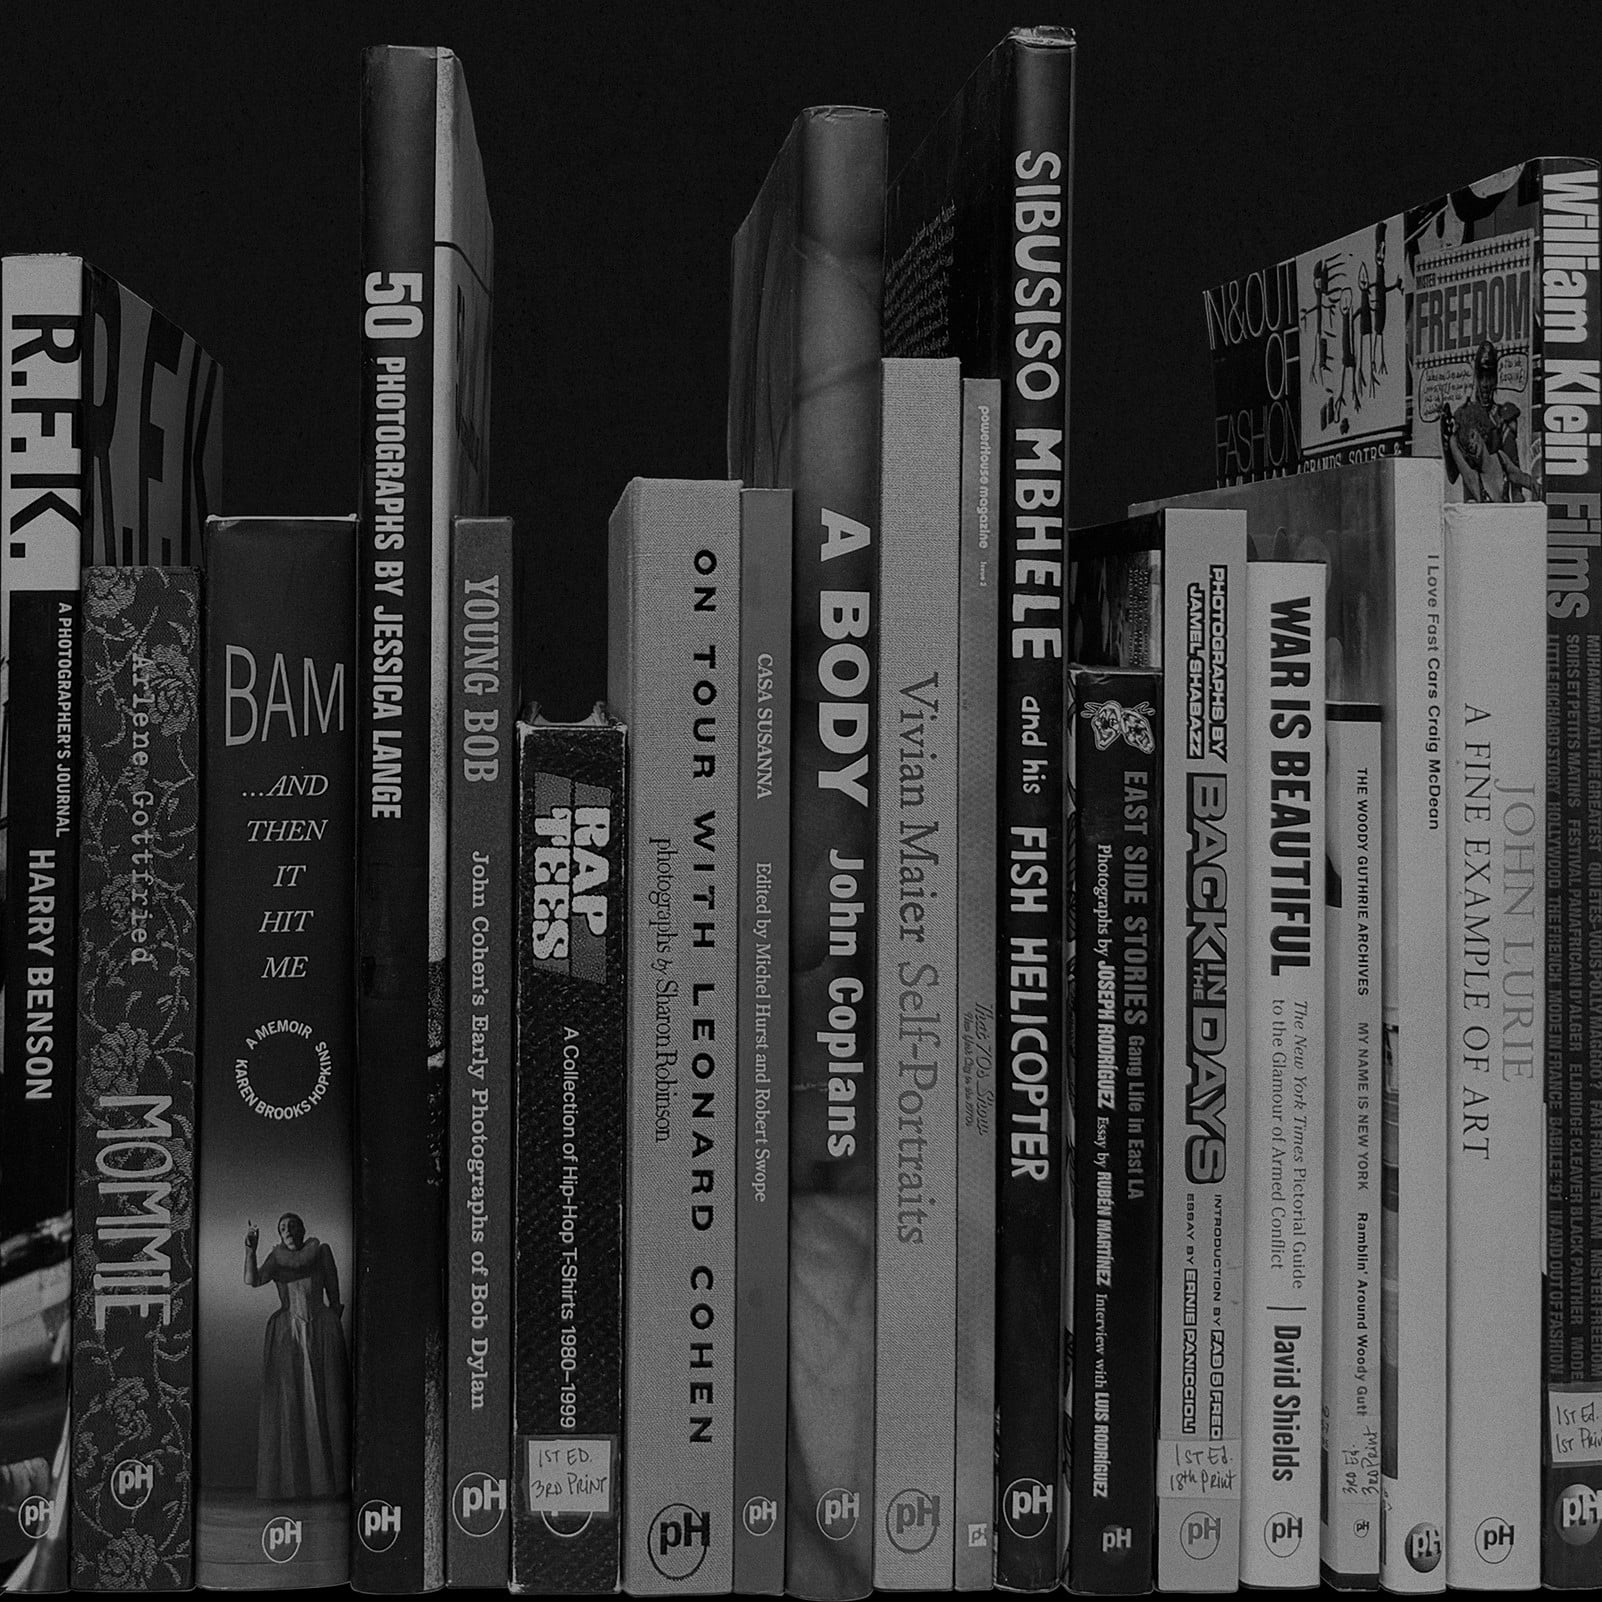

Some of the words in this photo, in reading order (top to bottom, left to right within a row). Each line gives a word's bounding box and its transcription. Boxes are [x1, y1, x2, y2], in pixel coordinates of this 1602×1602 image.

[1014, 150, 1062, 400] SIBUSISO
[1542, 169, 1601, 344] William
[364, 271, 424, 339] 50
[1415, 270, 1530, 356] FREEDOM
[1265, 327, 1299, 400] OF
[11, 315, 82, 558] R.F.K.
[977, 405, 991, 485] powerHouse
[1215, 400, 1301, 477] FASHION
[1542, 359, 1601, 477] Klein
[374, 357, 406, 550] PHOTOGRAPHS
[820, 507, 871, 562] A
[976, 486, 991, 549] magazine
[1012, 428, 1062, 660] MBHELE
[373, 560, 403, 597] BY
[693, 549, 716, 613] ON
[1428, 565, 1440, 608] Love
[1546, 492, 1602, 619] Films
[55, 602, 72, 616] A
[463, 575, 499, 696] YOUNG
[1187, 583, 1204, 657] JAMEL
[1210, 565, 1227, 721] PHOTOGRAPHS
[1270, 597, 1311, 689] WAR
[1428, 613, 1440, 652] Fast
[55, 618, 72, 760] PHOTOGRAPHER'S
[225, 644, 345, 747] BAM
[371, 604, 402, 720] JESSICA
[756, 653, 773, 703] CASA
[1428, 657, 1440, 699] Cars
[131, 656, 154, 766] Arlene
[692, 645, 716, 780] TOUR
[817, 590, 871, 809] BODY
[1021, 695, 1049, 747] and
[1187, 658, 1204, 759] SHABAZZ
[1270, 699, 1311, 740] IS
[1425, 705, 1441, 753] Craig
[1463, 702, 1491, 727] A
[370, 729, 401, 819] LANGE
[463, 708, 499, 783] BOB
[756, 707, 773, 800] SUSANNA
[899, 672, 940, 810] Vivian
[1210, 724, 1227, 763] BY
[55, 763, 72, 838] JOURNAL
[242, 774, 329, 797] ...AND
[1021, 759, 1049, 795] his
[1123, 770, 1148, 836] EAST
[1356, 768, 1369, 796] THE
[1428, 759, 1441, 831] McDean
[1463, 742, 1491, 823] FINE
[247, 820, 328, 842] THEN
[1356, 799, 1369, 852] WOODY
[1493, 778, 1537, 918] JOHN
[131, 791, 154, 965] Gottfried
[272, 865, 306, 887] IT
[471, 850, 489, 909] John
[531, 807, 573, 961] TEES
[571, 807, 611, 936] RAP
[649, 837, 677, 954] photographs
[692, 811, 715, 949] WITH
[755, 862, 771, 917] Edited
[899, 820, 940, 943] Maier
[1009, 826, 1049, 914] FISH
[1092, 843, 1113, 936] Photographs
[1123, 845, 1148, 905] SIDE
[1185, 773, 1227, 960] BACK
[1270, 750, 1311, 977] BEAUTIFUL
[1356, 856, 1369, 920] GUTHRIE
[25, 849, 54, 955] HARRY
[258, 910, 314, 932] HIT
[753, 918, 771, 939] by
[828, 848, 865, 957] John
[1463, 838, 1491, 1011] EXAMPLE
[261, 956, 309, 979] ME
[471, 916, 489, 1006] Cohen's
[651, 958, 673, 976] by
[755, 942, 771, 999] Michel
[1092, 938, 1113, 957] by
[1123, 915, 1148, 1026] STORIES
[1191, 963, 1205, 1001] THE
[1207, 963, 1226, 1000] IN
[1356, 923, 1369, 997] ARCHIVES
[655, 979, 679, 1049] Sharon
[975, 1002, 994, 1041] That
[1096, 959, 1116, 1021] JOSEPH
[1291, 1000, 1308, 1030] The
[1502, 938, 1536, 1083] LURIE
[25, 967, 54, 1099] BENSON
[245, 1036, 257, 1050] A
[255, 1019, 313, 1041] MEMOIR
[467, 1014, 489, 1080] Early
[564, 1026, 579, 1041] A
[754, 1002, 770, 1050] Hurst
[1009, 937, 1049, 1182] HELICOPTER
[1126, 1034, 1145, 1078] Gang
[1291, 1034, 1308, 1069] New
[1463, 1026, 1491, 1073] OF
[234, 1058, 258, 1112] KAREN
[254, 1098, 311, 1121] BROOKS
[307, 1040, 333, 1111] HOPKINS
[562, 1045, 579, 1139] Collection
[754, 1053, 770, 1084] and
[816, 976, 865, 1158] Coplans
[975, 1043, 994, 1079] 70s
[1096, 1022, 1119, 1111] RODRÍGUEZ
[1185, 1006, 1227, 1185] DAYS
[1291, 1075, 1308, 1110] York
[654, 1050, 678, 1144] Robinson
[691, 983, 715, 1232] LEONARD
[753, 1087, 770, 1145] Robert
[896, 961, 941, 1246] Self-Portraits
[975, 1081, 994, 1137] Show
[1127, 1081, 1145, 1113] Life
[1127, 1118, 1145, 1135] in
[1463, 1085, 1491, 1161] ART
[467, 1088, 489, 1243] Photographs
[562, 1143, 578, 1164] of
[1127, 1139, 1145, 1175] East
[1291, 1115, 1308, 1163] Times
[559, 1166, 578, 1244] Hip-Hop
[751, 1147, 769, 1203] Swope
[1127, 1179, 1145, 1200] LA
[1291, 1167, 1308, 1238] Pictorial
[93, 1095, 172, 1330] MOMMIE
[1186, 1193, 1195, 1241] ESSAY
[470, 1251, 488, 1276] of
[560, 1248, 578, 1320] T-Shirts
[1185, 1245, 1194, 1265] BY
[1291, 1241, 1308, 1290] Guide
[470, 1283, 488, 1330] Bob
[1184, 1268, 1197, 1326] ERNIE
[466, 1337, 488, 1411] Dylan
[559, 1324, 577, 1429] 1980–1999
[689, 1265, 714, 1444] COHEN
[1182, 1328, 1197, 1435] PANICCIOLI
[1271, 1325, 1301, 1389] David
[1271, 1394, 1301, 1483] Shields
[119, 1464, 154, 1494] pH
[1011, 1485, 1055, 1519] pH
[364, 1505, 401, 1535] pH
[661, 1511, 711, 1556] pH
[1102, 1528, 1132, 1552] pH
[1484, 1525, 1515, 1550] pH
